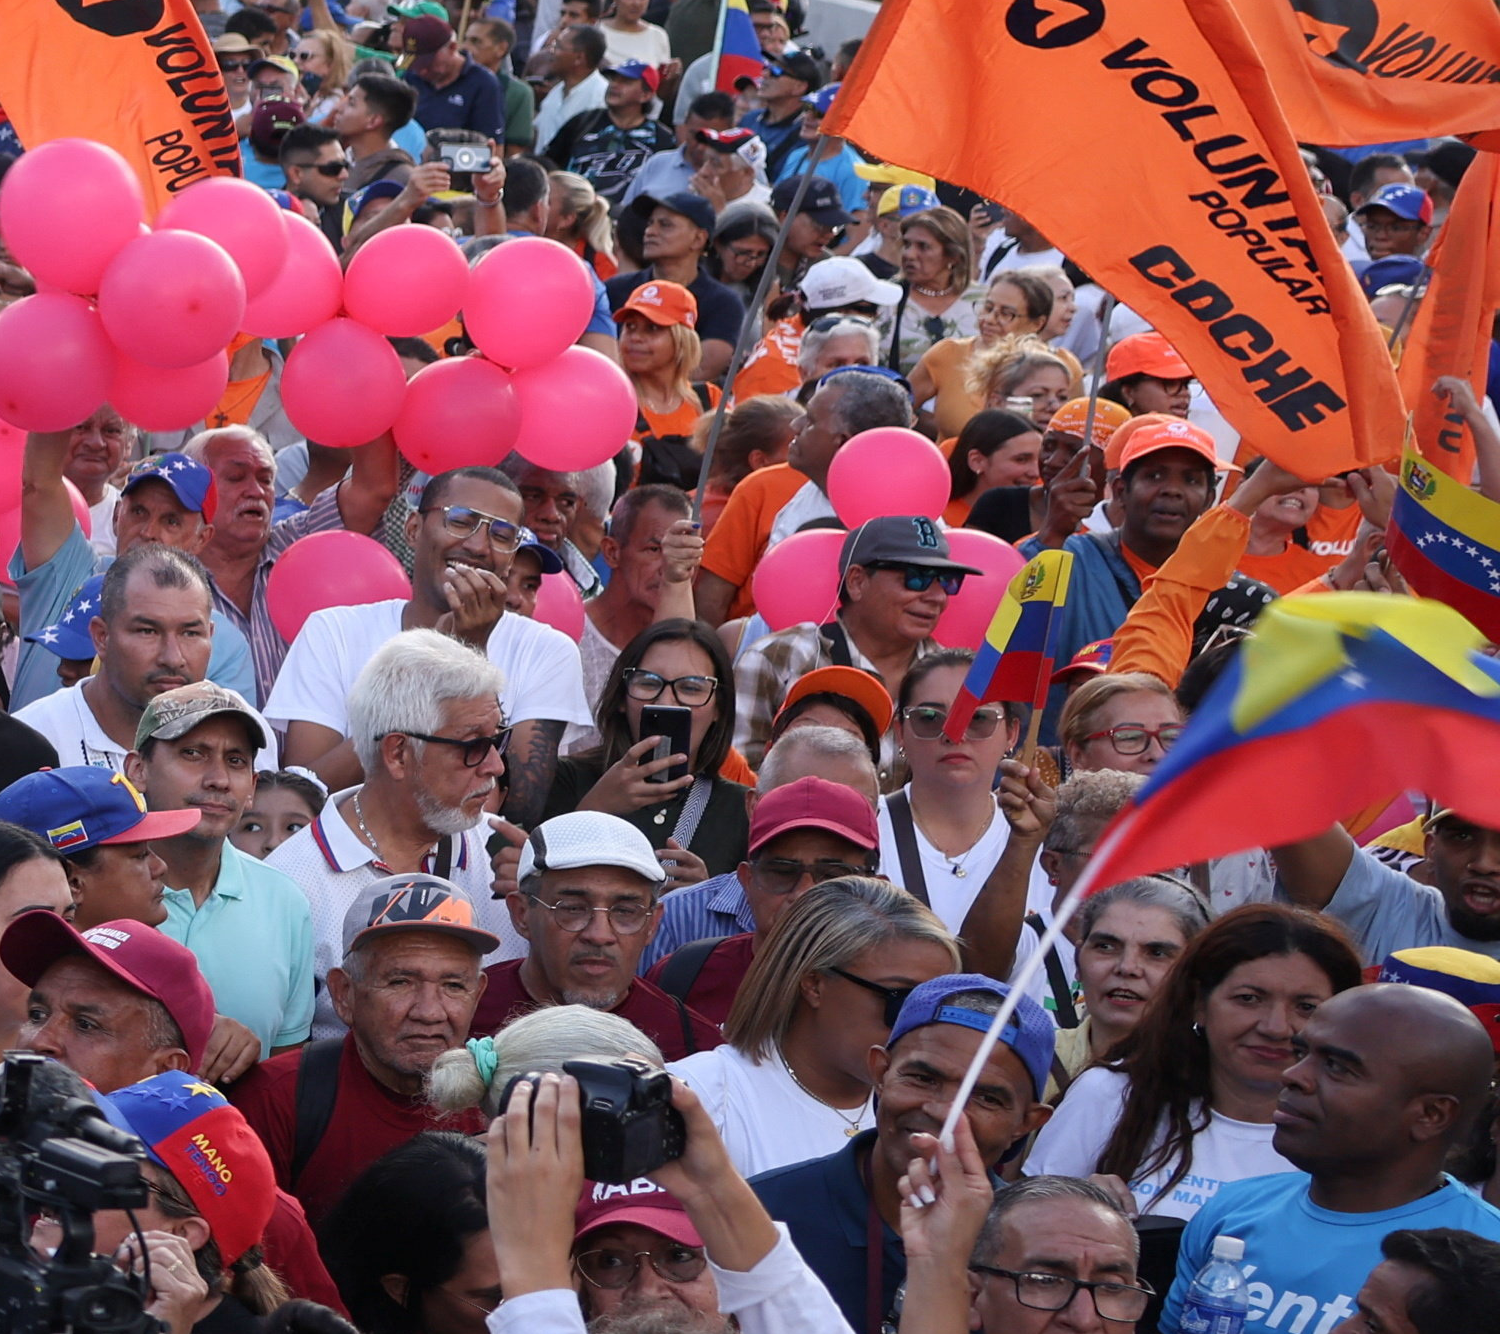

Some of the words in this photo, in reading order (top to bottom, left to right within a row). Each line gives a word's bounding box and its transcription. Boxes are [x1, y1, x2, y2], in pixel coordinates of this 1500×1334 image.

[1101, 37, 1327, 278] VOLUNTA
[1128, 244, 1346, 435] COCHE
[912, 516, 939, 549] B
[367, 881, 472, 927] KTM
[183, 1143, 228, 1197] TENGO
[190, 1132, 233, 1184] MANO
